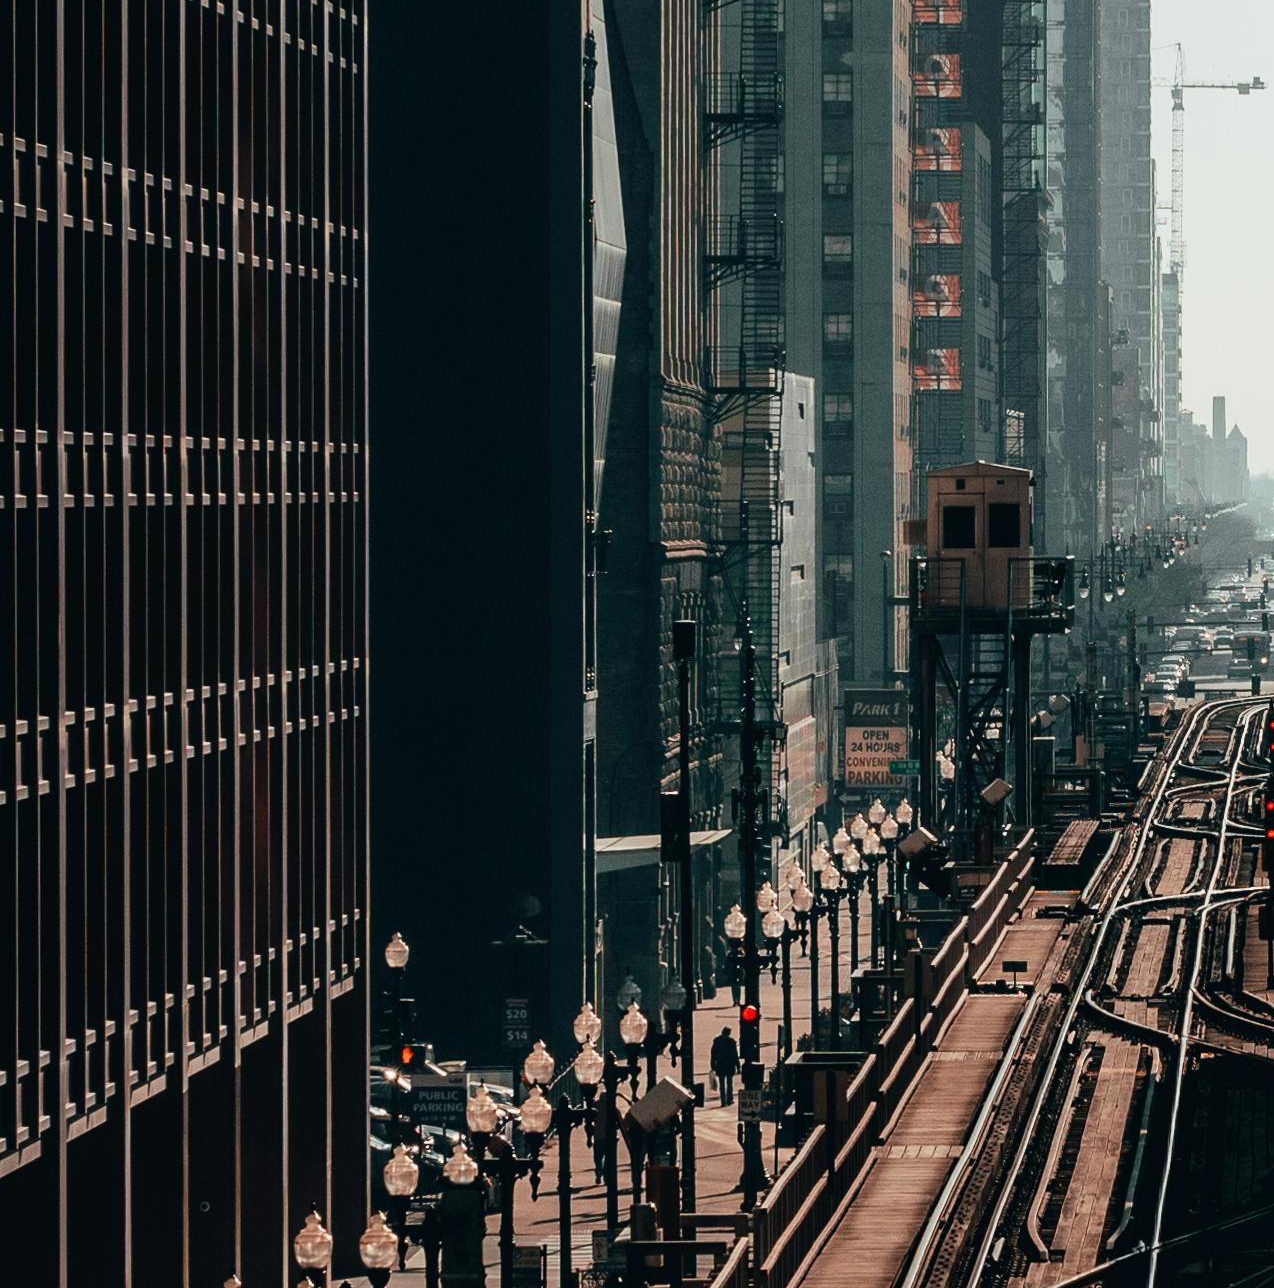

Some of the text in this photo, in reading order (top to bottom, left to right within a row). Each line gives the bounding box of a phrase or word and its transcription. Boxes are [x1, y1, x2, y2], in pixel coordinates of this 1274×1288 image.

[852, 702, 890, 716] PARK
[862, 730, 890, 741] OPEN
[851, 743, 901, 753] 24 HOURS
[846, 757, 906, 768] CONVENI
[848, 771, 904, 785] PARKING
[505, 1009, 528, 1020] $20
[506, 1030, 528, 1041] $14
[419, 1090, 459, 1101] PUBLIC
[413, 1102, 465, 1112] PARKING
